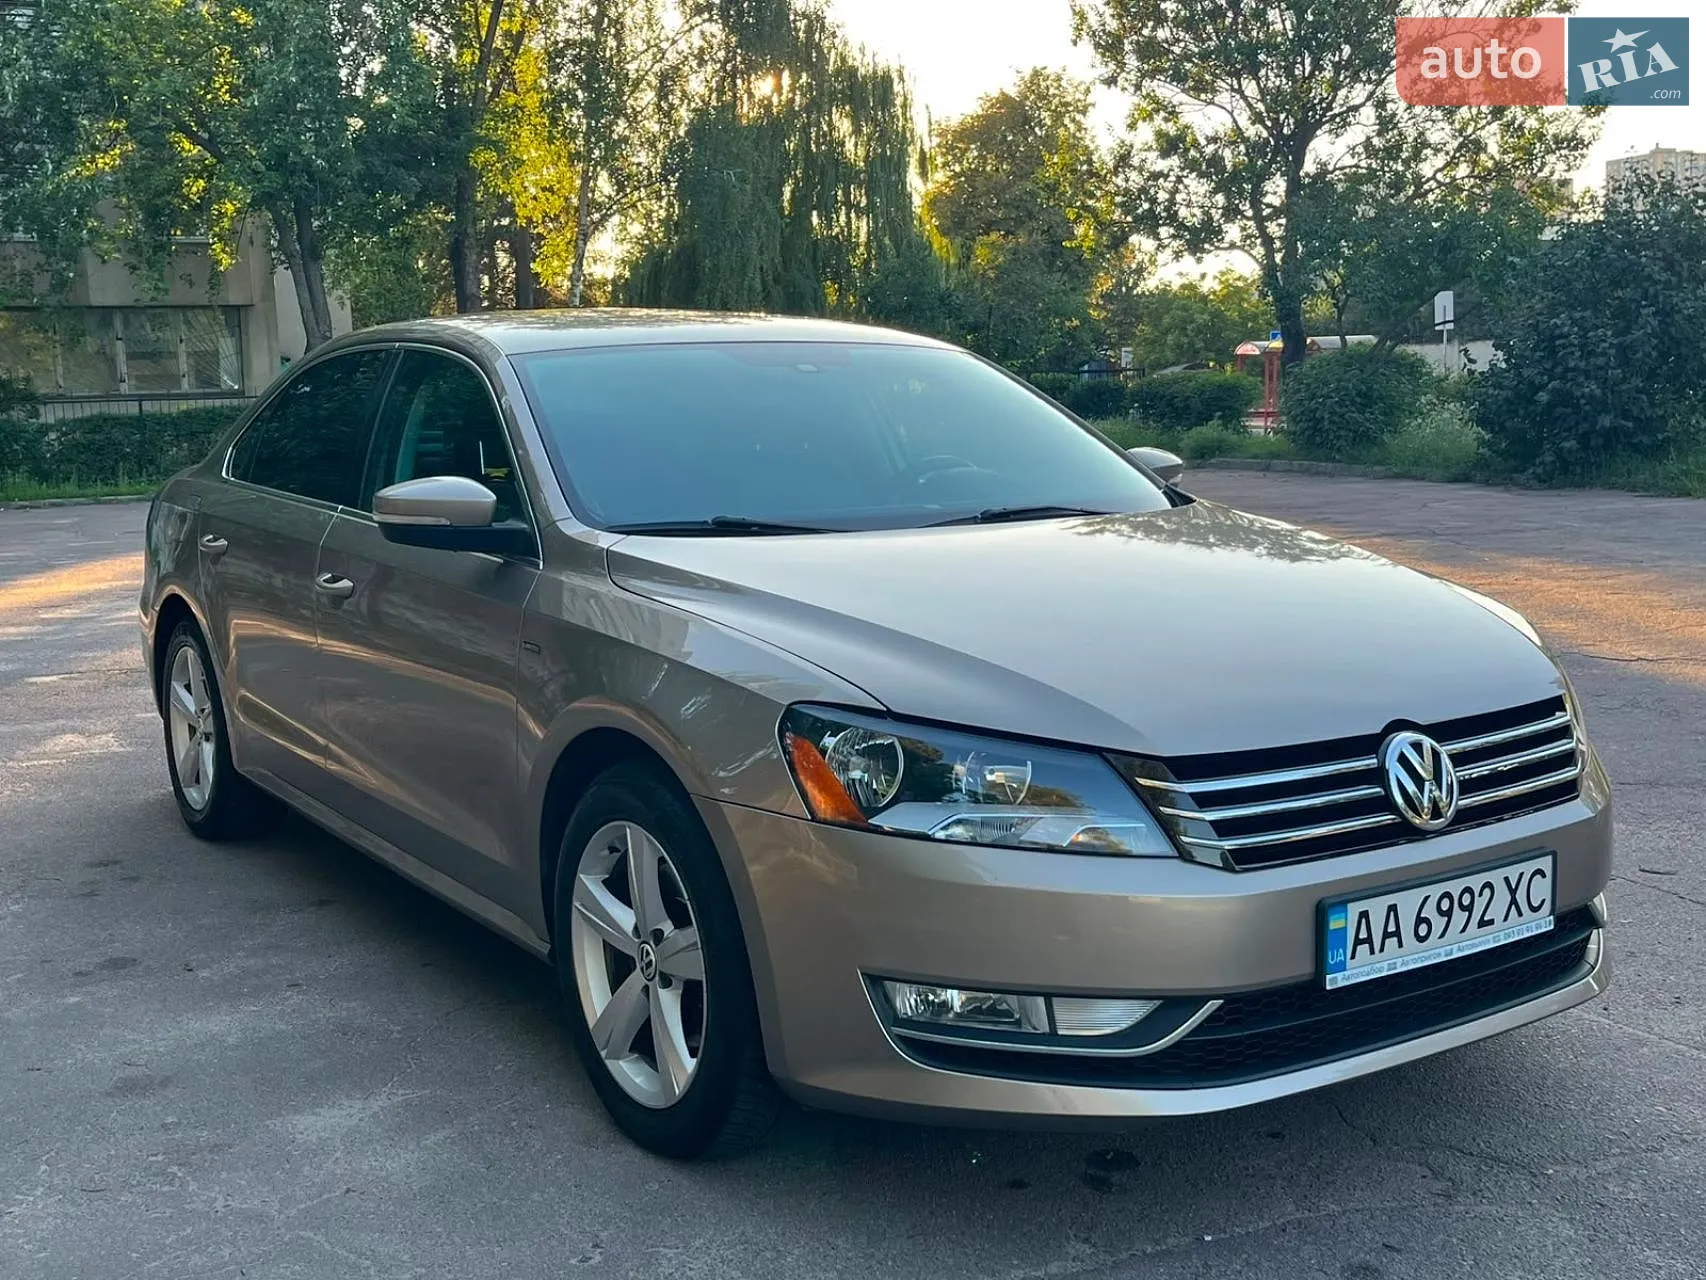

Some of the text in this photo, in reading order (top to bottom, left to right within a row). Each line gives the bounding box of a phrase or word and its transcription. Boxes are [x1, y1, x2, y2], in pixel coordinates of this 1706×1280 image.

[1385, 732, 1457, 829] VW
[1328, 947, 1345, 965] UA
[1350, 867, 1547, 960] AA 6992 XC
